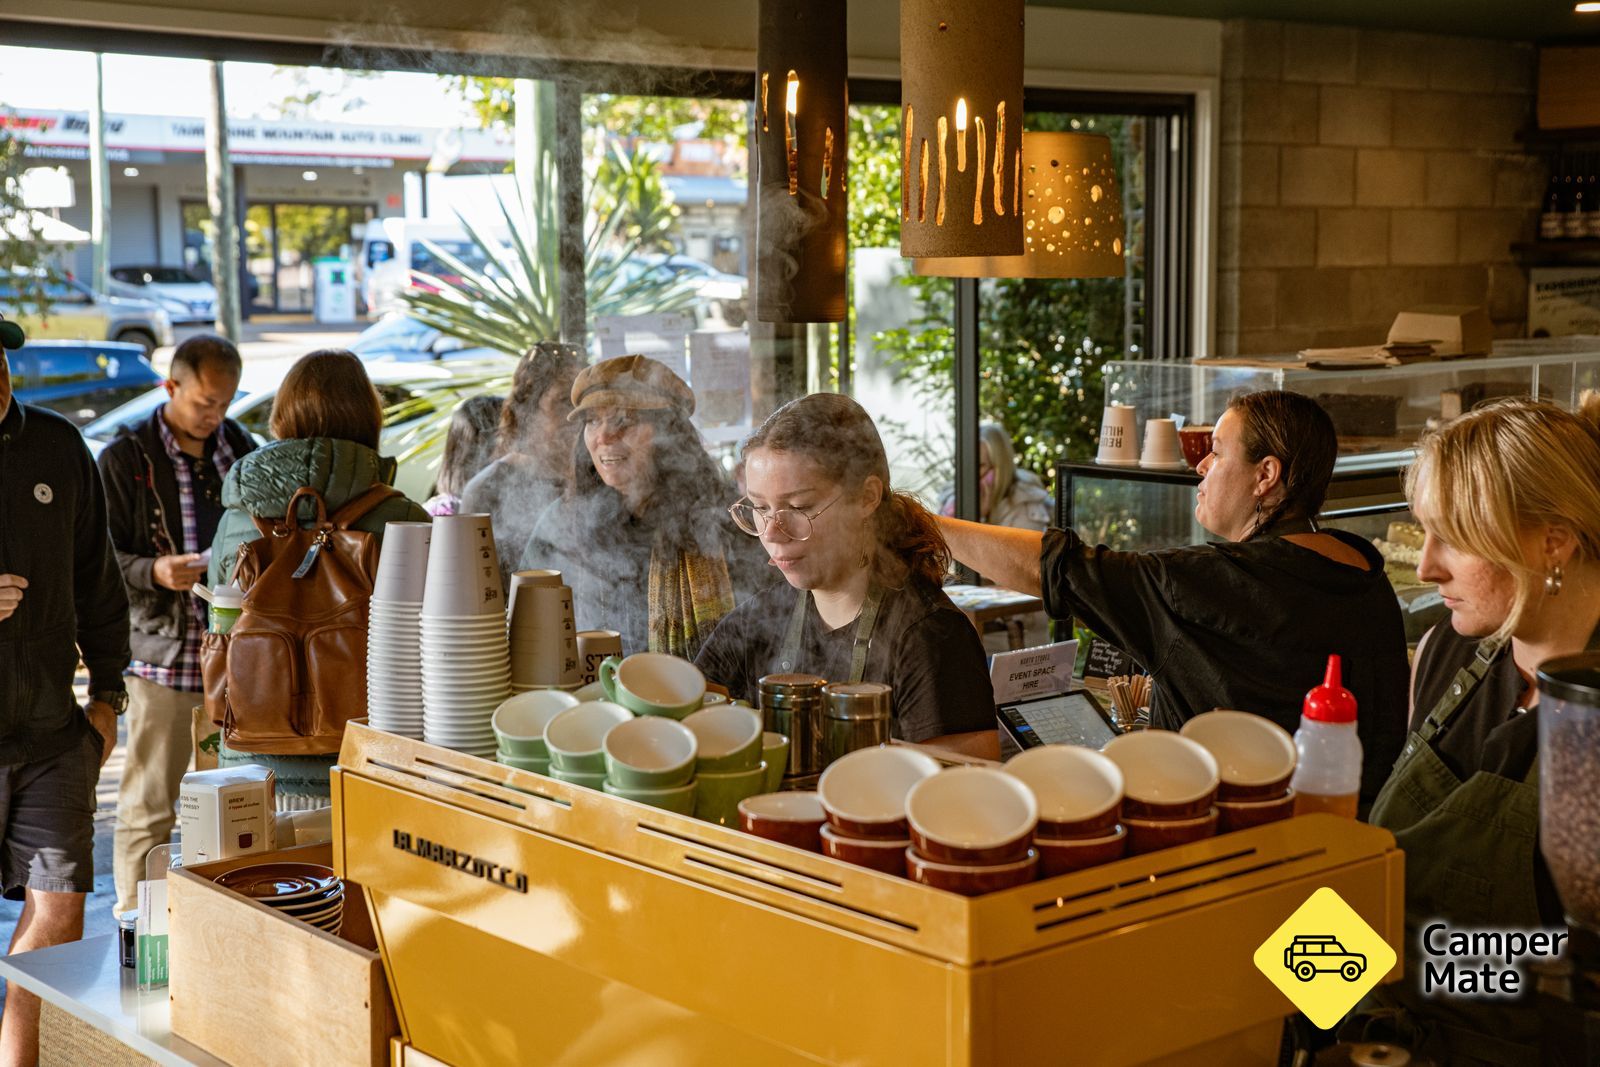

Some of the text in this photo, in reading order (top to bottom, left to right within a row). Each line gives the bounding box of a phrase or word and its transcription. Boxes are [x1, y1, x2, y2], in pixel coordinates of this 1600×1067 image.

[1009, 666, 1056, 682] EVENT SPACE
[1022, 680, 1039, 690] HIRE
